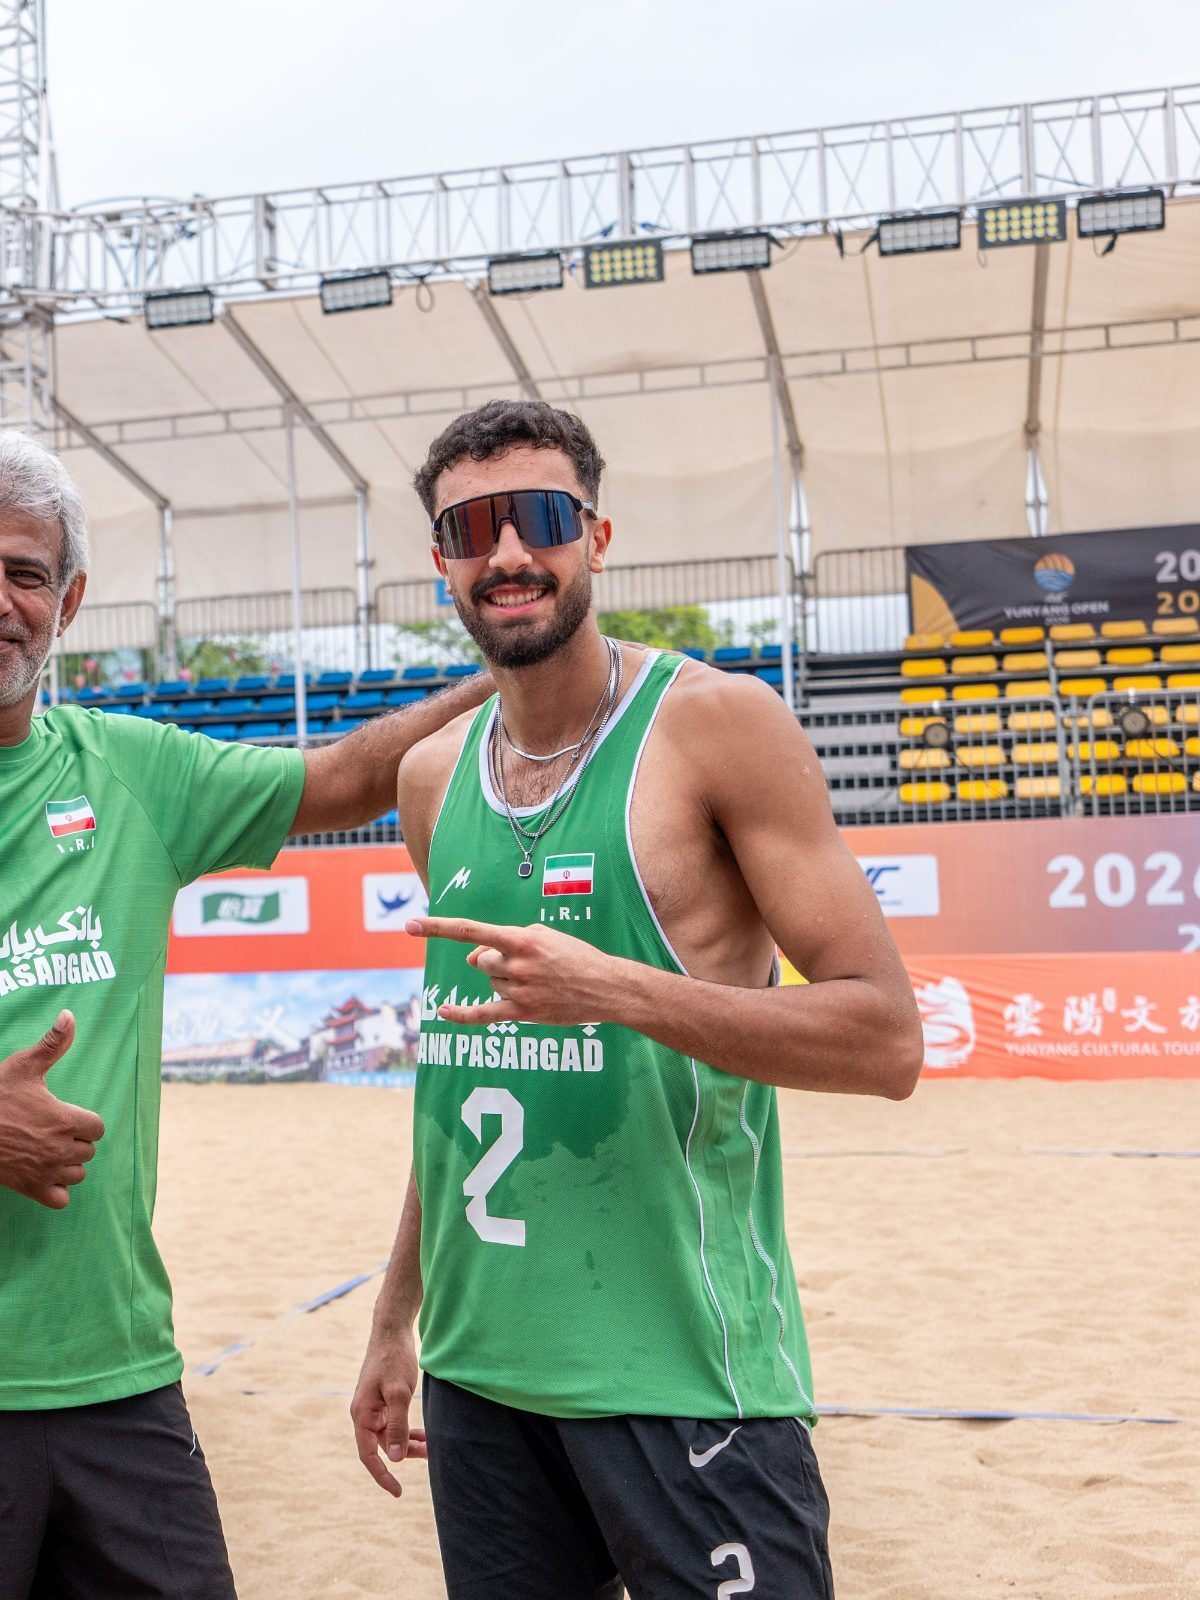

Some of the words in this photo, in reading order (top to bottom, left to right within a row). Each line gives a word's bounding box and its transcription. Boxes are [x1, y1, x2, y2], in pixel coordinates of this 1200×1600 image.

[1004, 605, 1070, 620] YUNYANG
[1071, 602, 1109, 616] OPEN
[1046, 851, 1200, 908] 202
[33, 905, 103, 950] بانک
[417, 1032, 452, 1066] ANK
[455, 1034, 604, 1073] PASARGAD
[1004, 1041, 1080, 1057] YUNYANG
[1082, 1041, 1160, 1057] CULTURAL
[461, 1087, 526, 1246] 2
[710, 1542, 755, 1600] 2
